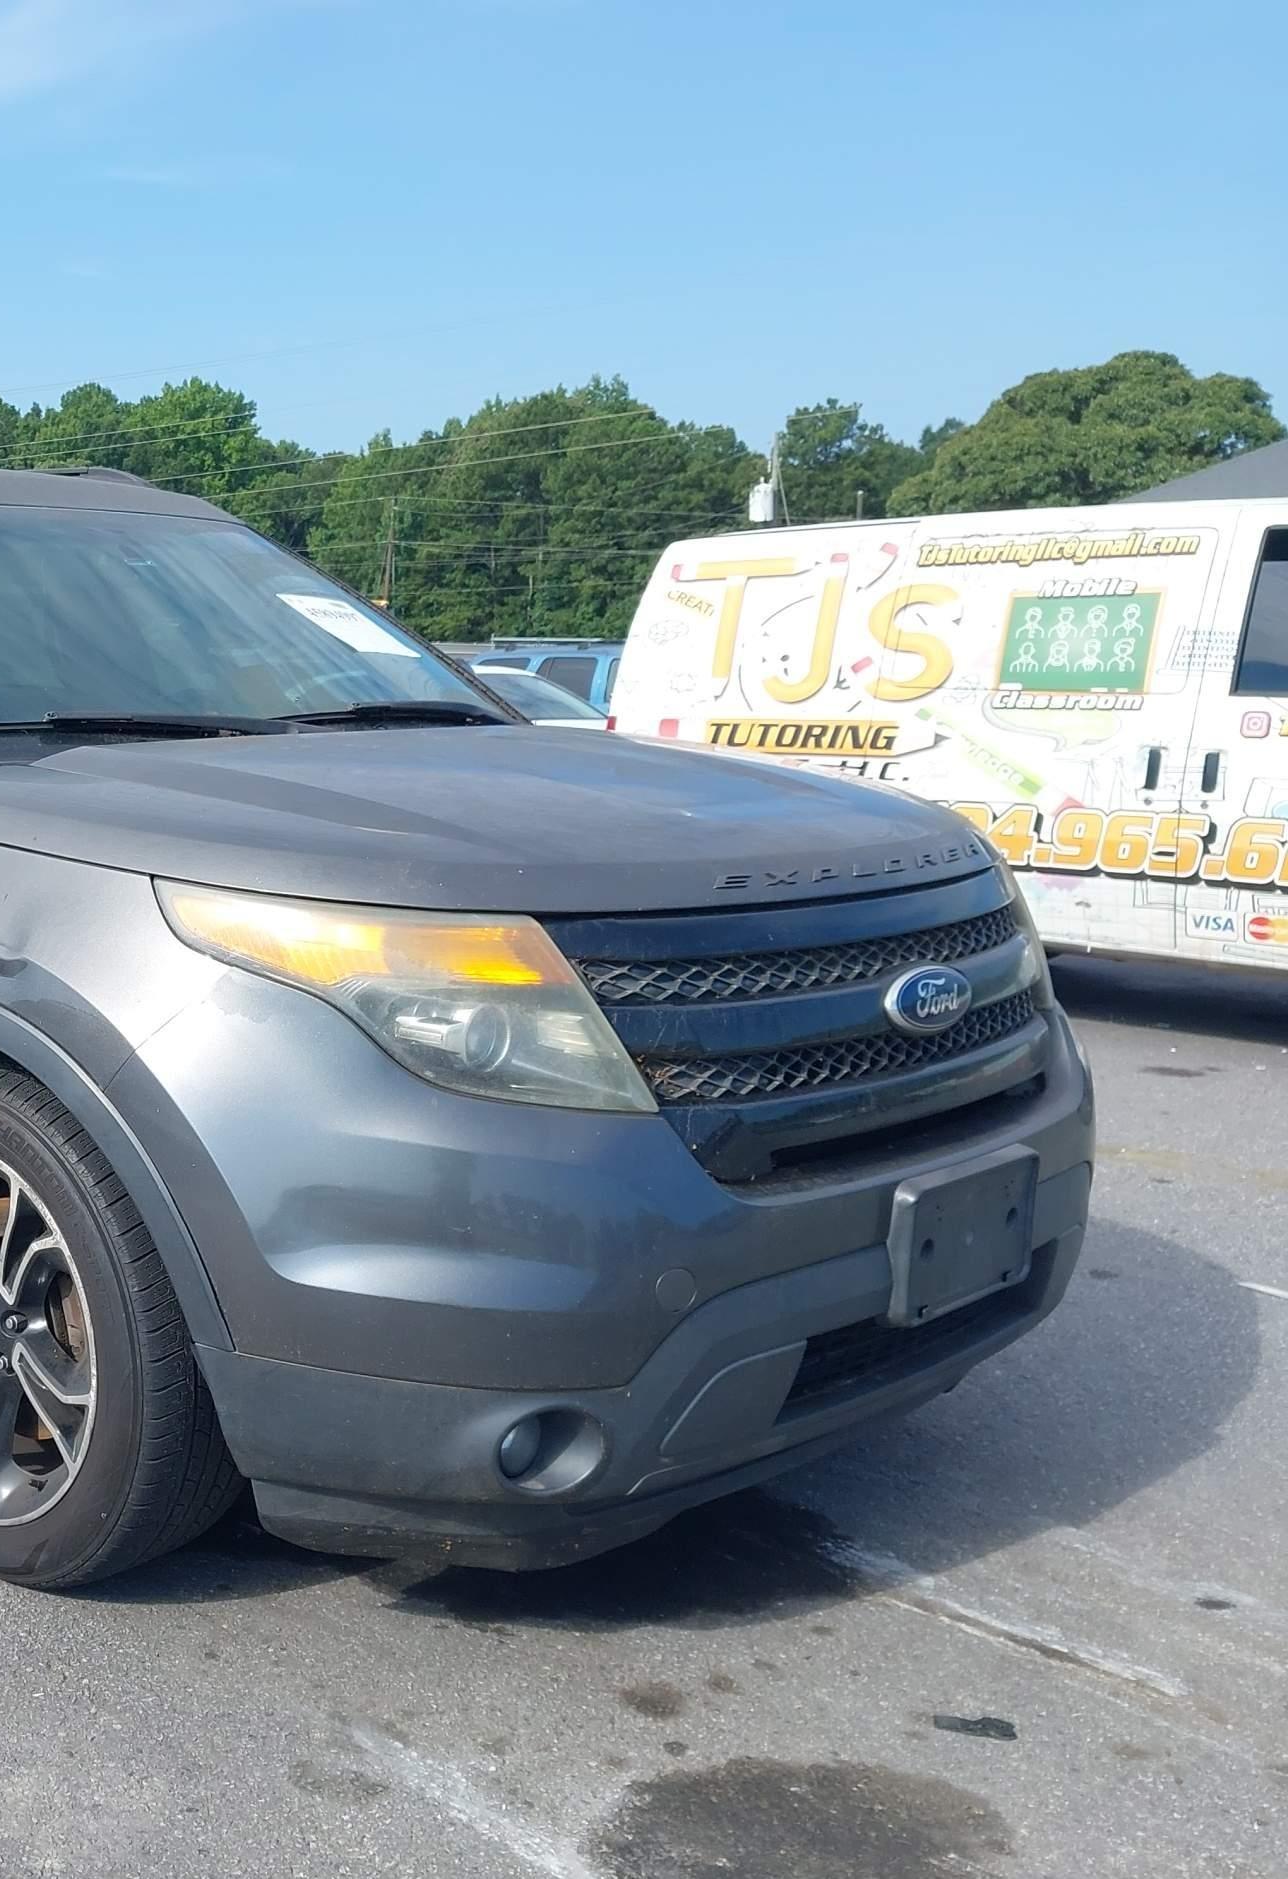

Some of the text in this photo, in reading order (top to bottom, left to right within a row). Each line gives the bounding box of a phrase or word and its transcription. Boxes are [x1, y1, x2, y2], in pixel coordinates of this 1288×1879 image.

[917, 532, 1201, 567] TJsTutoringllc@gmail.com
[1037, 577, 1139, 598] Mobile
[991, 691, 1146, 711] Classroom
[709, 722, 900, 750] TUTORING
[712, 843, 980, 890] EXPLORER
[1192, 914, 1235, 932] VISA
[917, 978, 961, 1018] Ford
